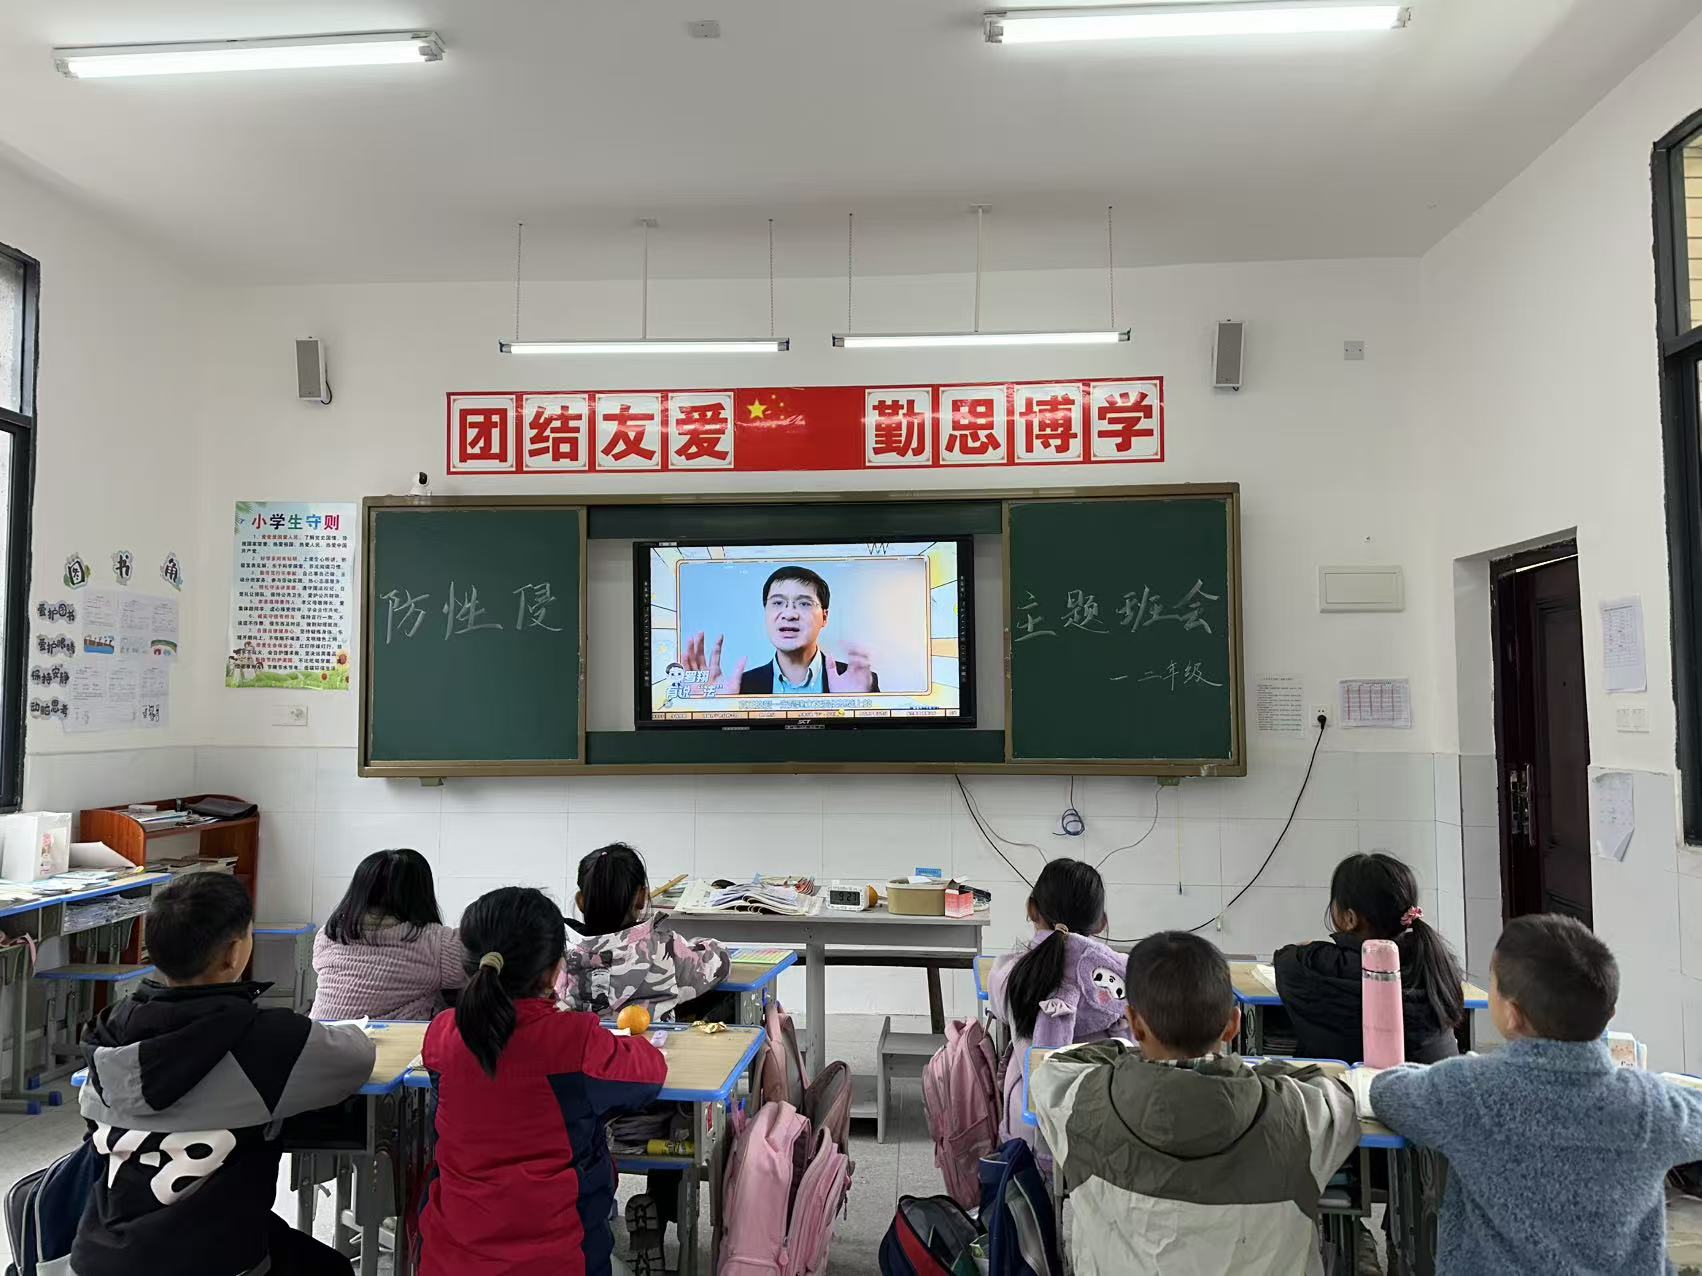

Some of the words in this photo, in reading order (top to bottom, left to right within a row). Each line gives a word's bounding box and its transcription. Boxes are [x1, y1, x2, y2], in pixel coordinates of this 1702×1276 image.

[458, 402, 730, 463] 团结友爱
[872, 393, 1154, 457] 勤思博学
[252, 513, 340, 530] 小学生守则
[380, 581, 563, 644] 防性侵
[1015, 579, 1219, 641] 主题班会
[31, 667, 70, 685] 保持安静
